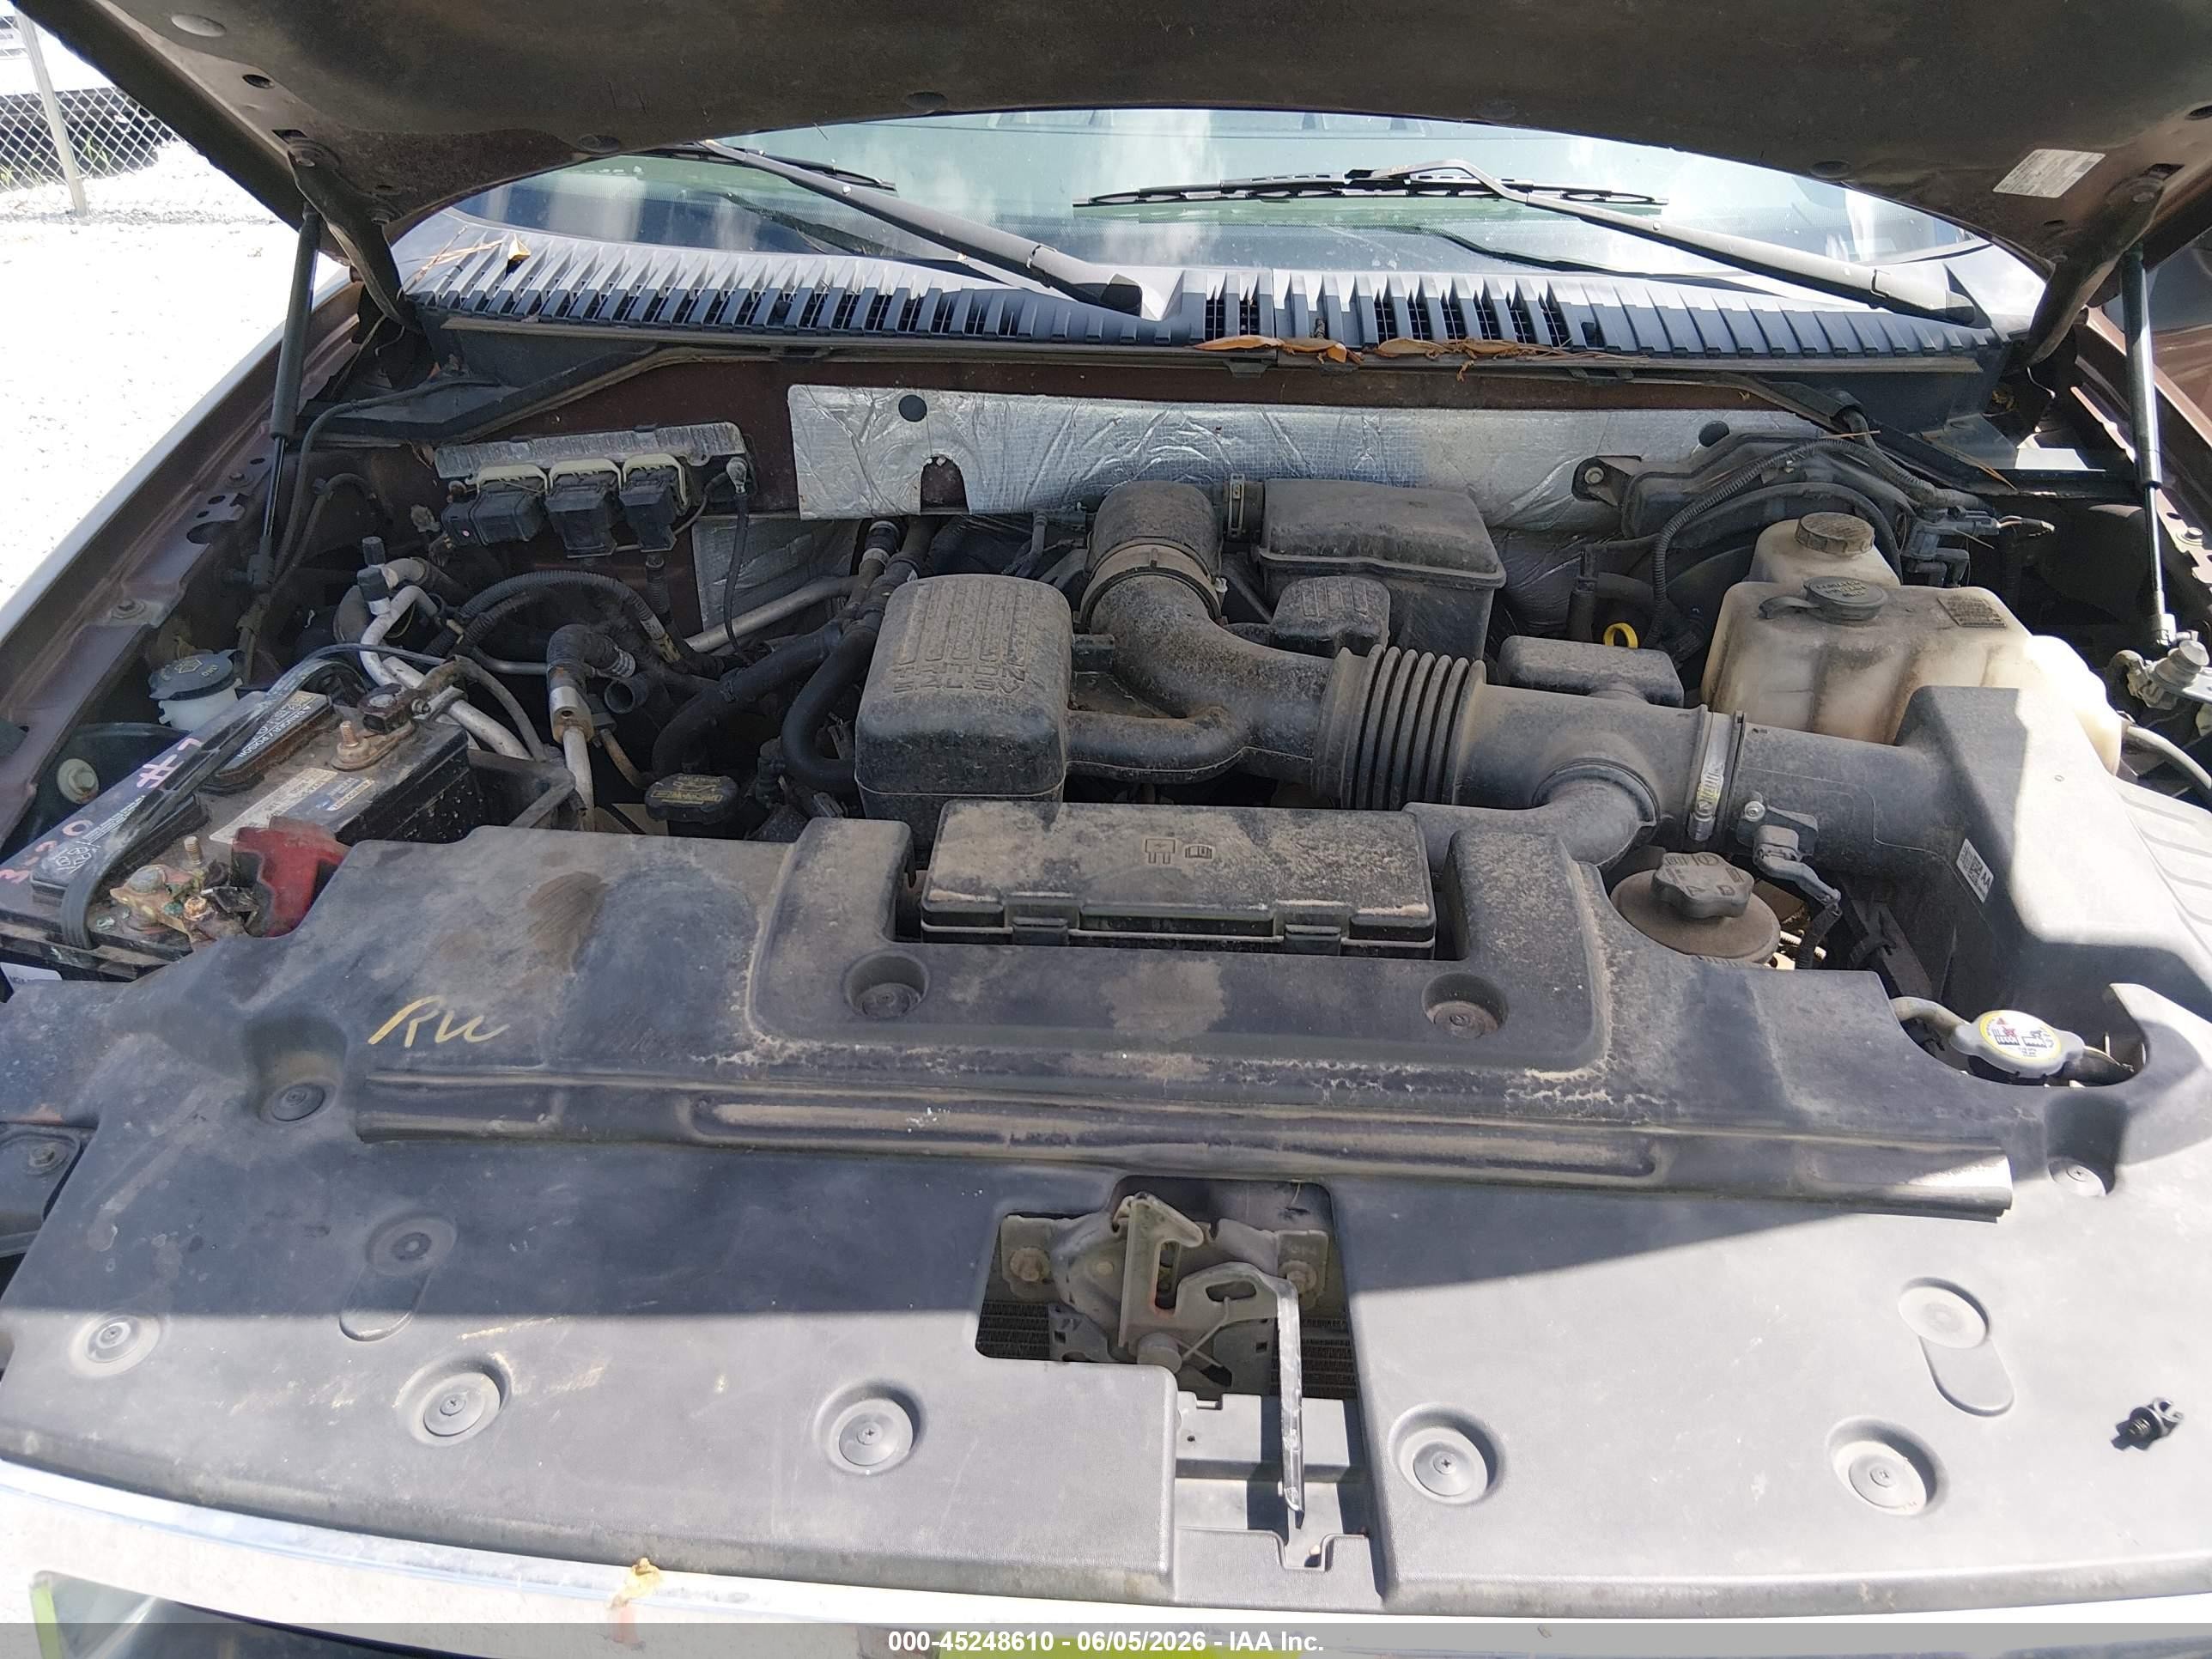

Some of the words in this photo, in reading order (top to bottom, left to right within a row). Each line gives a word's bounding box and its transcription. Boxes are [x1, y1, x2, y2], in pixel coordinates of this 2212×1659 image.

[893, 660, 1026, 682] TRITON
[273, 710, 306, 733] DANGER
[237, 737, 270, 758] POISON
